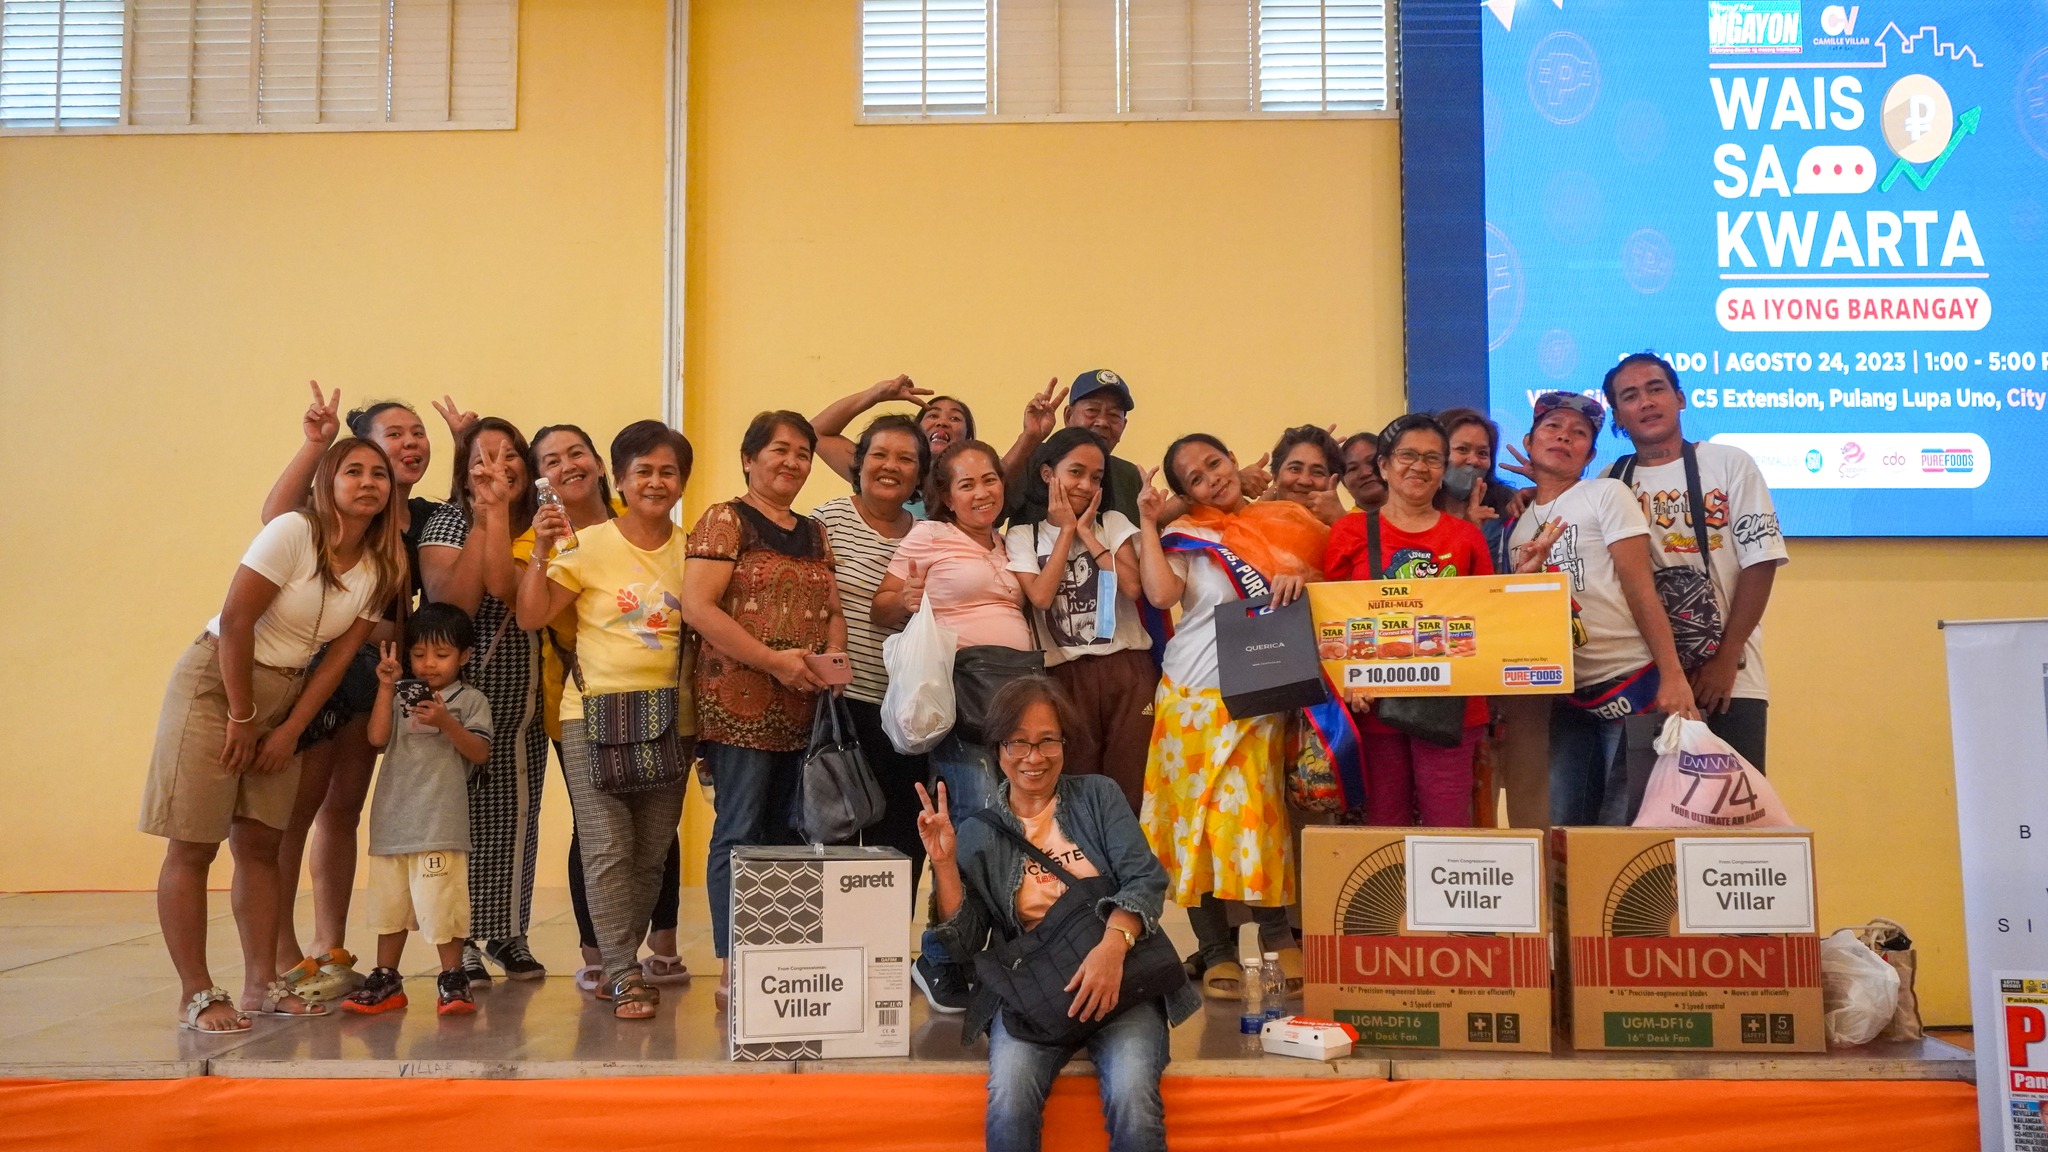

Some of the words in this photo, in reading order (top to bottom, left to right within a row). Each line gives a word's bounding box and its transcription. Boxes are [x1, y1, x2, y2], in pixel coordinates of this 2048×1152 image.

[1710, 12, 1799, 45] NGAYON
[1813, 37, 1844, 46] CAMILLE
[1845, 37, 1870, 46] VILLAR
[1709, 75, 1865, 131] WAIS
[1713, 144, 1792, 199] SA
[1716, 210, 1986, 268] KWARTA
[1728, 299, 1756, 321] SA
[1764, 299, 1840, 321] IYONG
[1849, 298, 1979, 320] BARANGAY
[1725, 352, 1813, 372] AGOSTO
[1818, 352, 1850, 375] 24,
[1855, 352, 1907, 372] 2023
[1924, 352, 1969, 371] 1:00
[1988, 351, 2036, 372] 5:00
[1691, 388, 1719, 408] C5
[1723, 388, 1825, 411] Extension,
[1830, 387, 1898, 411] Pulang
[1902, 387, 1952, 411] Lupa
[1956, 387, 2002, 411] Uno,
[2006, 387, 2047, 411] City
[1882, 451, 1907, 466] cdo
[1921, 453, 1975, 468] PUREFOODS
[1381, 586, 1409, 596] STAR
[1367, 600, 1424, 610] NUTRI-MEATS
[1351, 622, 1372, 631] STAR
[1381, 620, 1409, 629] STAR
[1417, 621, 1441, 630] STAR
[1449, 622, 1472, 631] STAR
[1322, 628, 1344, 637] STAR
[1245, 642, 1285, 652] QUERICA
[1366, 666, 1441, 684] 10,000.00
[1504, 670, 1563, 682] PUREFOODS
[1678, 769, 1758, 814] 774
[1671, 803, 1690, 819] YOUR
[1691, 811, 1730, 826] ULTIMATE
[1731, 815, 1745, 825] AM
[1745, 808, 1766, 823] RADIO
[429, 857, 441, 869] H
[422, 871, 449, 879] FASHION
[839, 871, 895, 893] garett
[1430, 866, 1514, 886] Camille
[1702, 868, 1787, 887] Camille
[1443, 889, 1502, 909] Villar
[1716, 891, 1776, 910] Villar
[761, 973, 844, 994] Camille
[774, 998, 832, 1018] Villar
[1351, 1015, 1422, 1028] UGM-DF16
[1504, 1015, 1514, 1029] 5
[1622, 1017, 1694, 1030] UGM-DF16
[1778, 1016, 1787, 1030] 5
[1375, 1031, 1398, 1041] Desk
[1400, 1032, 1418, 1041] Fan
[1647, 1033, 1670, 1043] Desk
[1673, 1034, 1691, 1043] Fan
